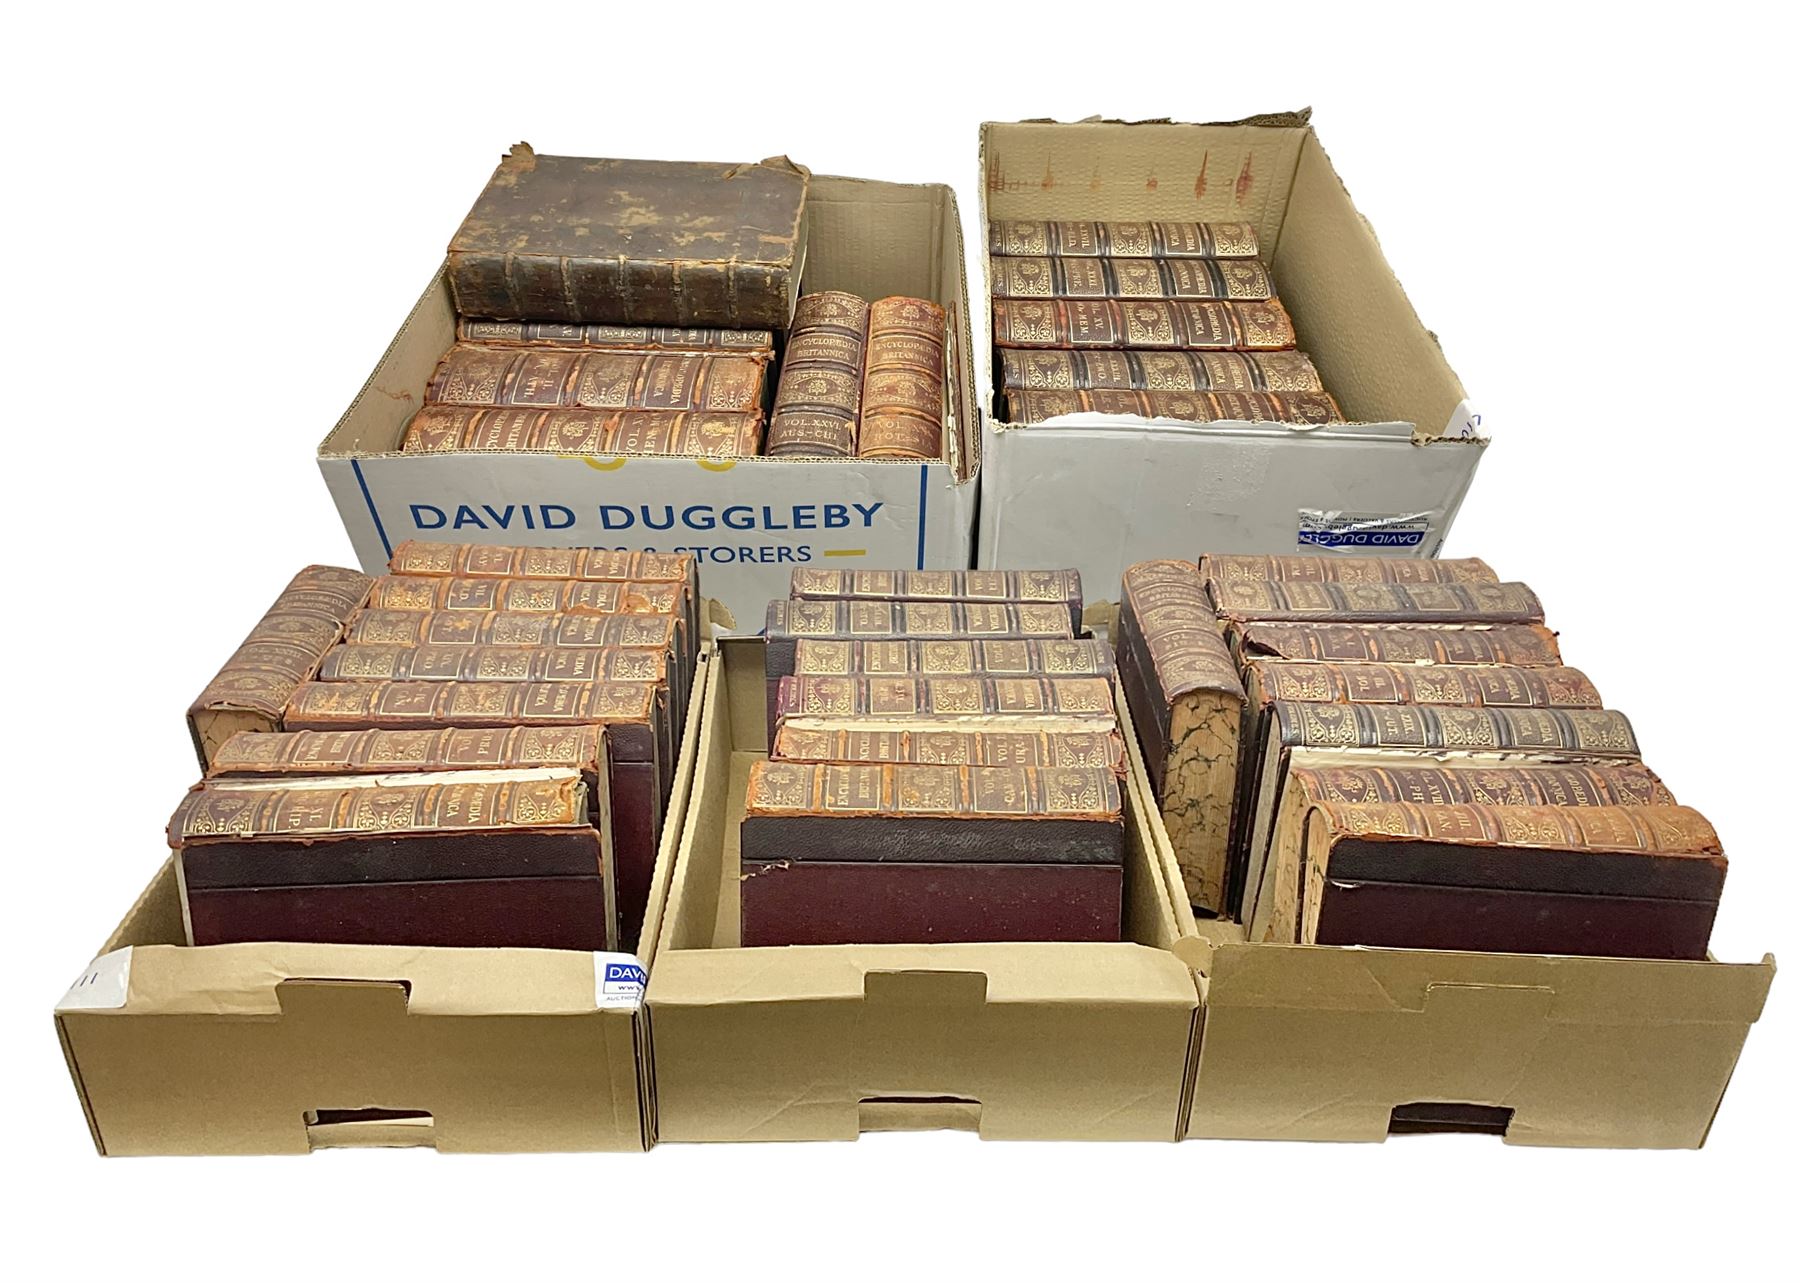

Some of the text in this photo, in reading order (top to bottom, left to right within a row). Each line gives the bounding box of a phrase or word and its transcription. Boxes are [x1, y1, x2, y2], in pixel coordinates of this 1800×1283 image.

[409, 502, 884, 530] DAVID DUGGLEBY
[1371, 534, 1420, 545] DAVID
